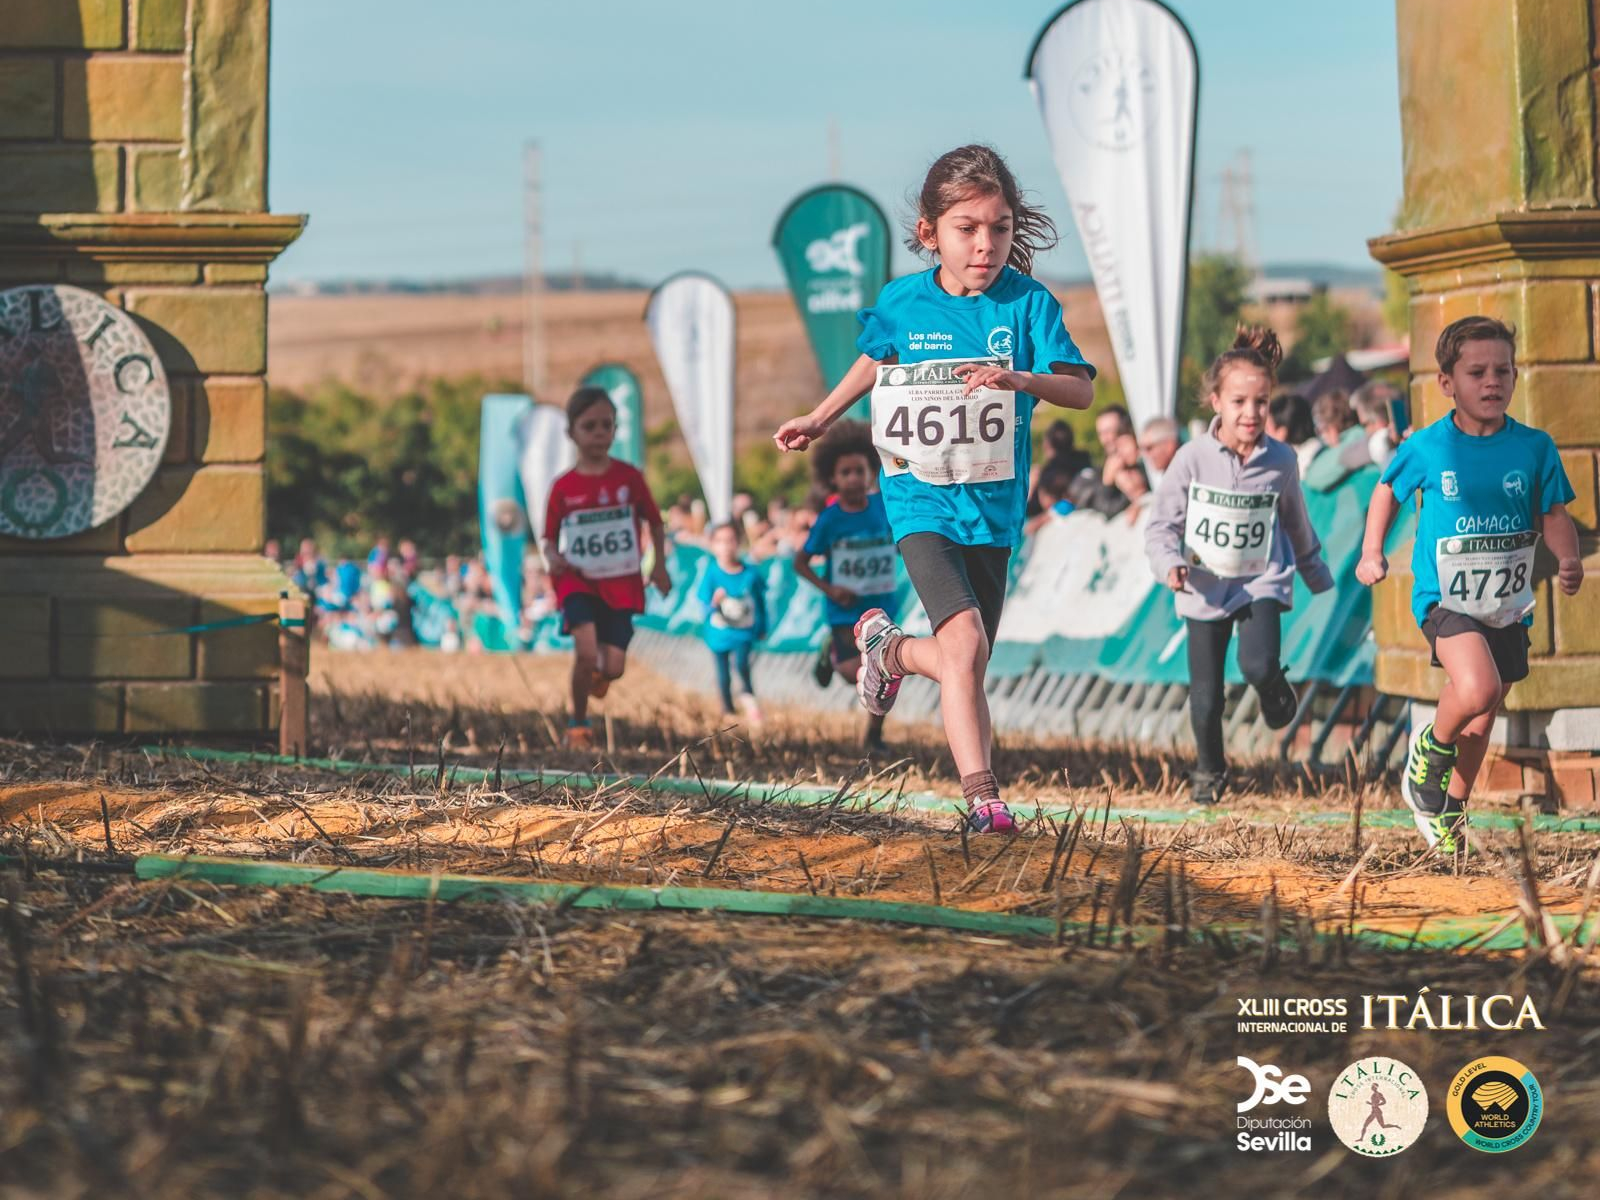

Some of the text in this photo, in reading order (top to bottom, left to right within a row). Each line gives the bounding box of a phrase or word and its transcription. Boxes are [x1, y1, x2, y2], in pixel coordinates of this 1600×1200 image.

[908, 331, 953, 341] Los niños
[908, 341, 953, 350] del barrio
[885, 402, 1005, 447] 4616
[571, 529, 633, 558] 4663
[1195, 517, 1265, 549] 4659
[838, 555, 892, 579] 4692
[1449, 562, 1527, 601] 4728
